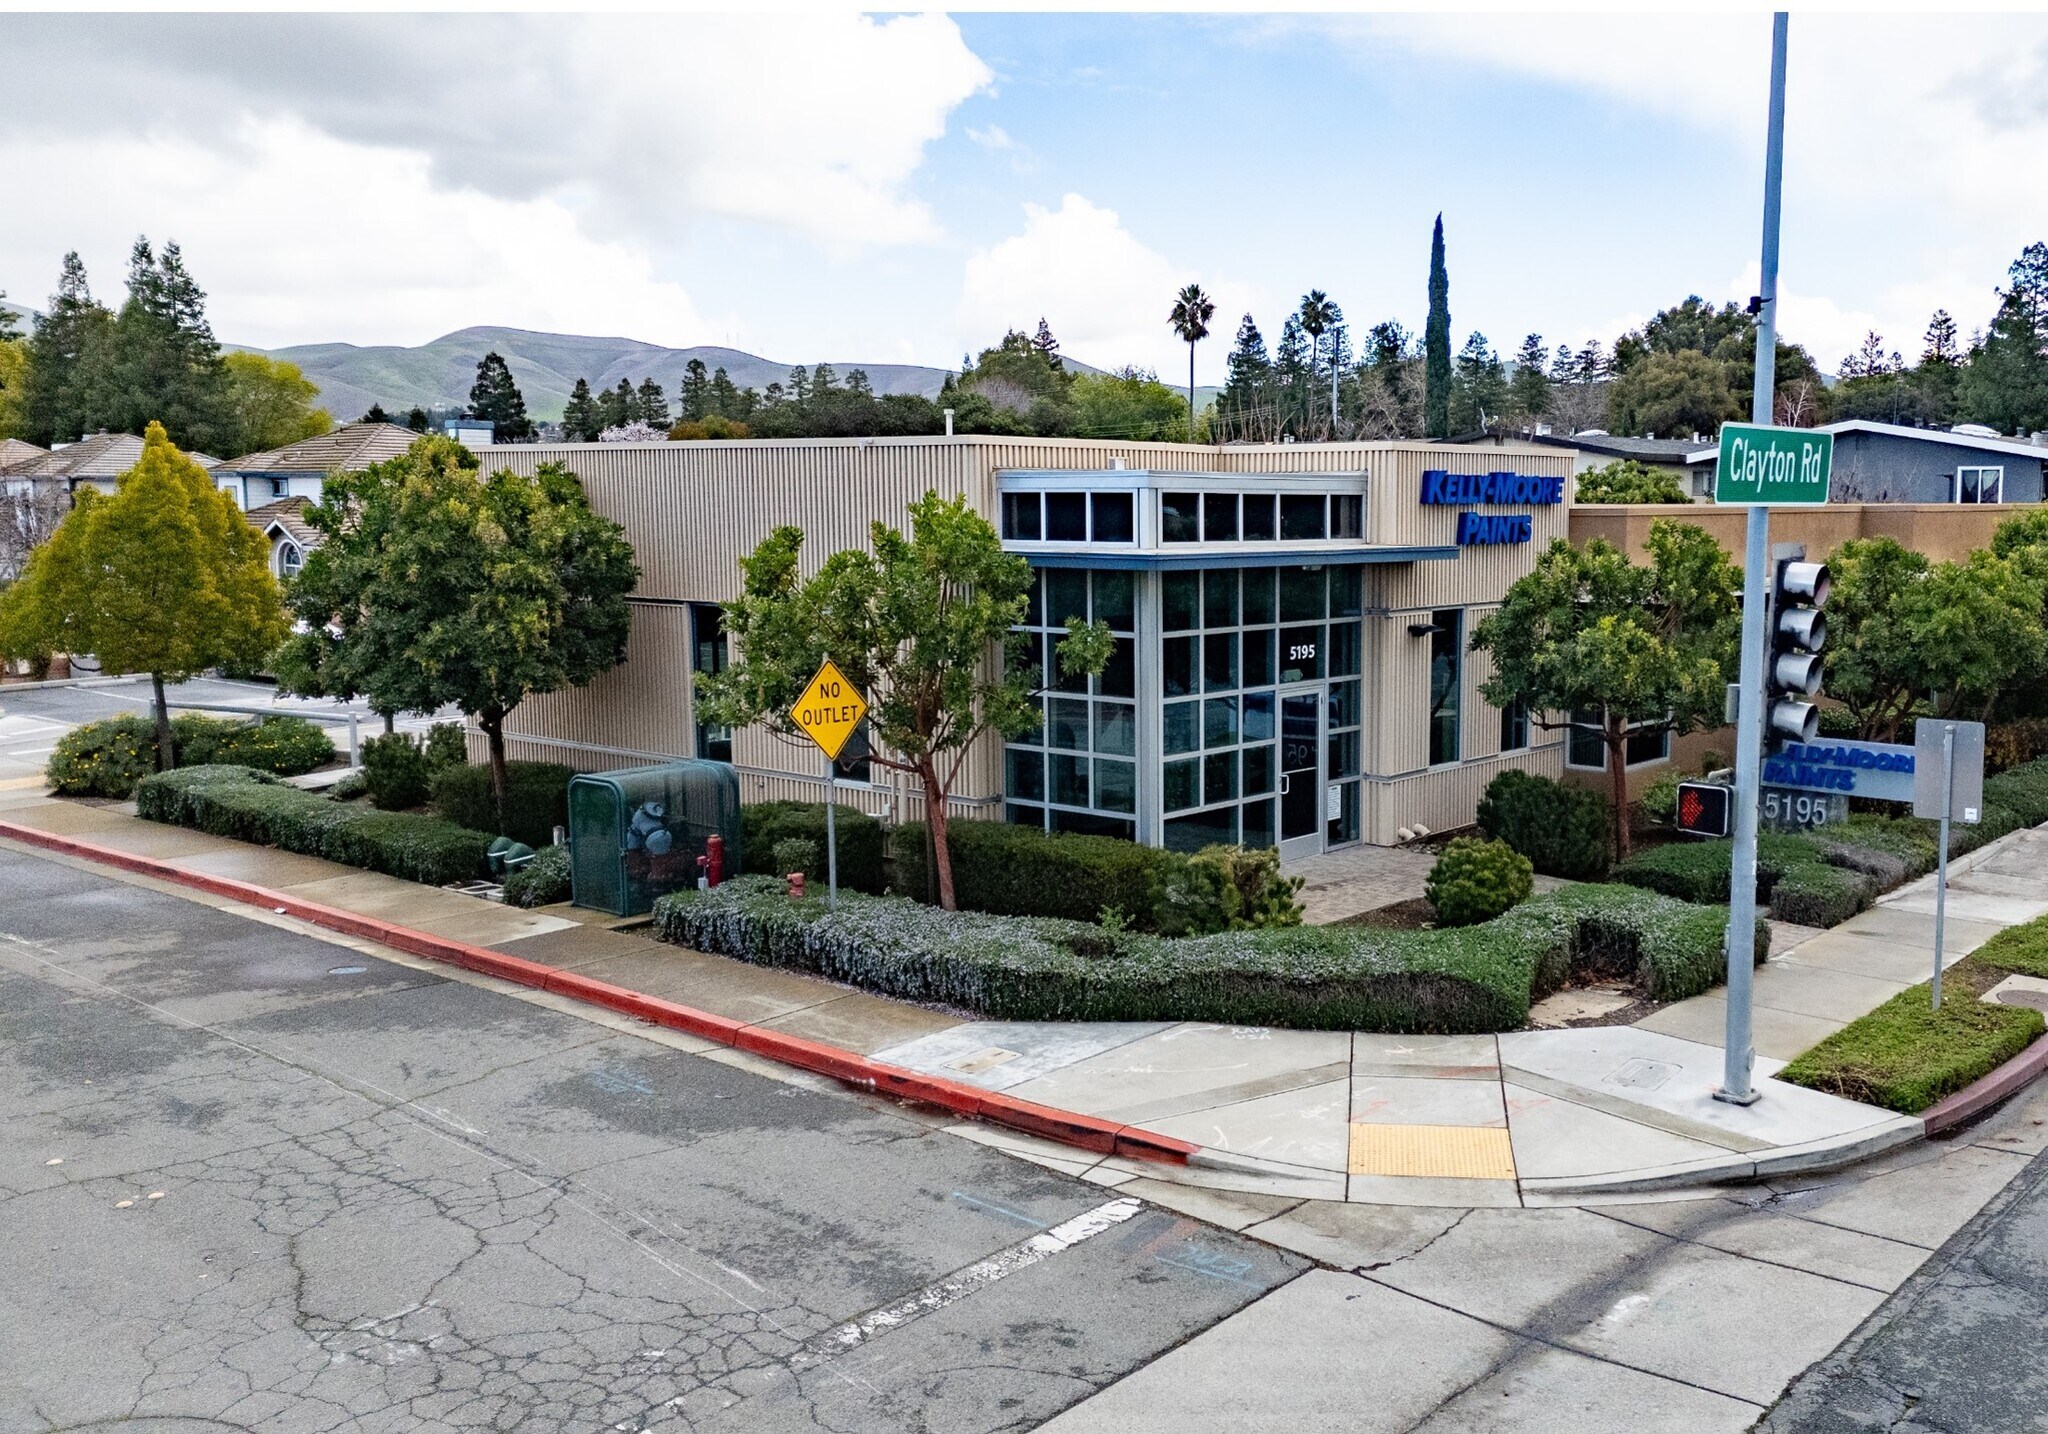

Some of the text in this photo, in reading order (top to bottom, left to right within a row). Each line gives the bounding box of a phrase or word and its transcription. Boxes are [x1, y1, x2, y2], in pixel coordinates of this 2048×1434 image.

[1730, 437, 1822, 493] Clayton Rd
[1421, 470, 1565, 505] KELLY-MOORE
[1457, 512, 1532, 545] PAINTS
[1289, 644, 1316, 660] 5195
[820, 682, 840, 699] NO
[802, 705, 858, 726] OUTLET
[1763, 762, 1857, 791] PAINTS
[1765, 794, 1828, 825] 5195
